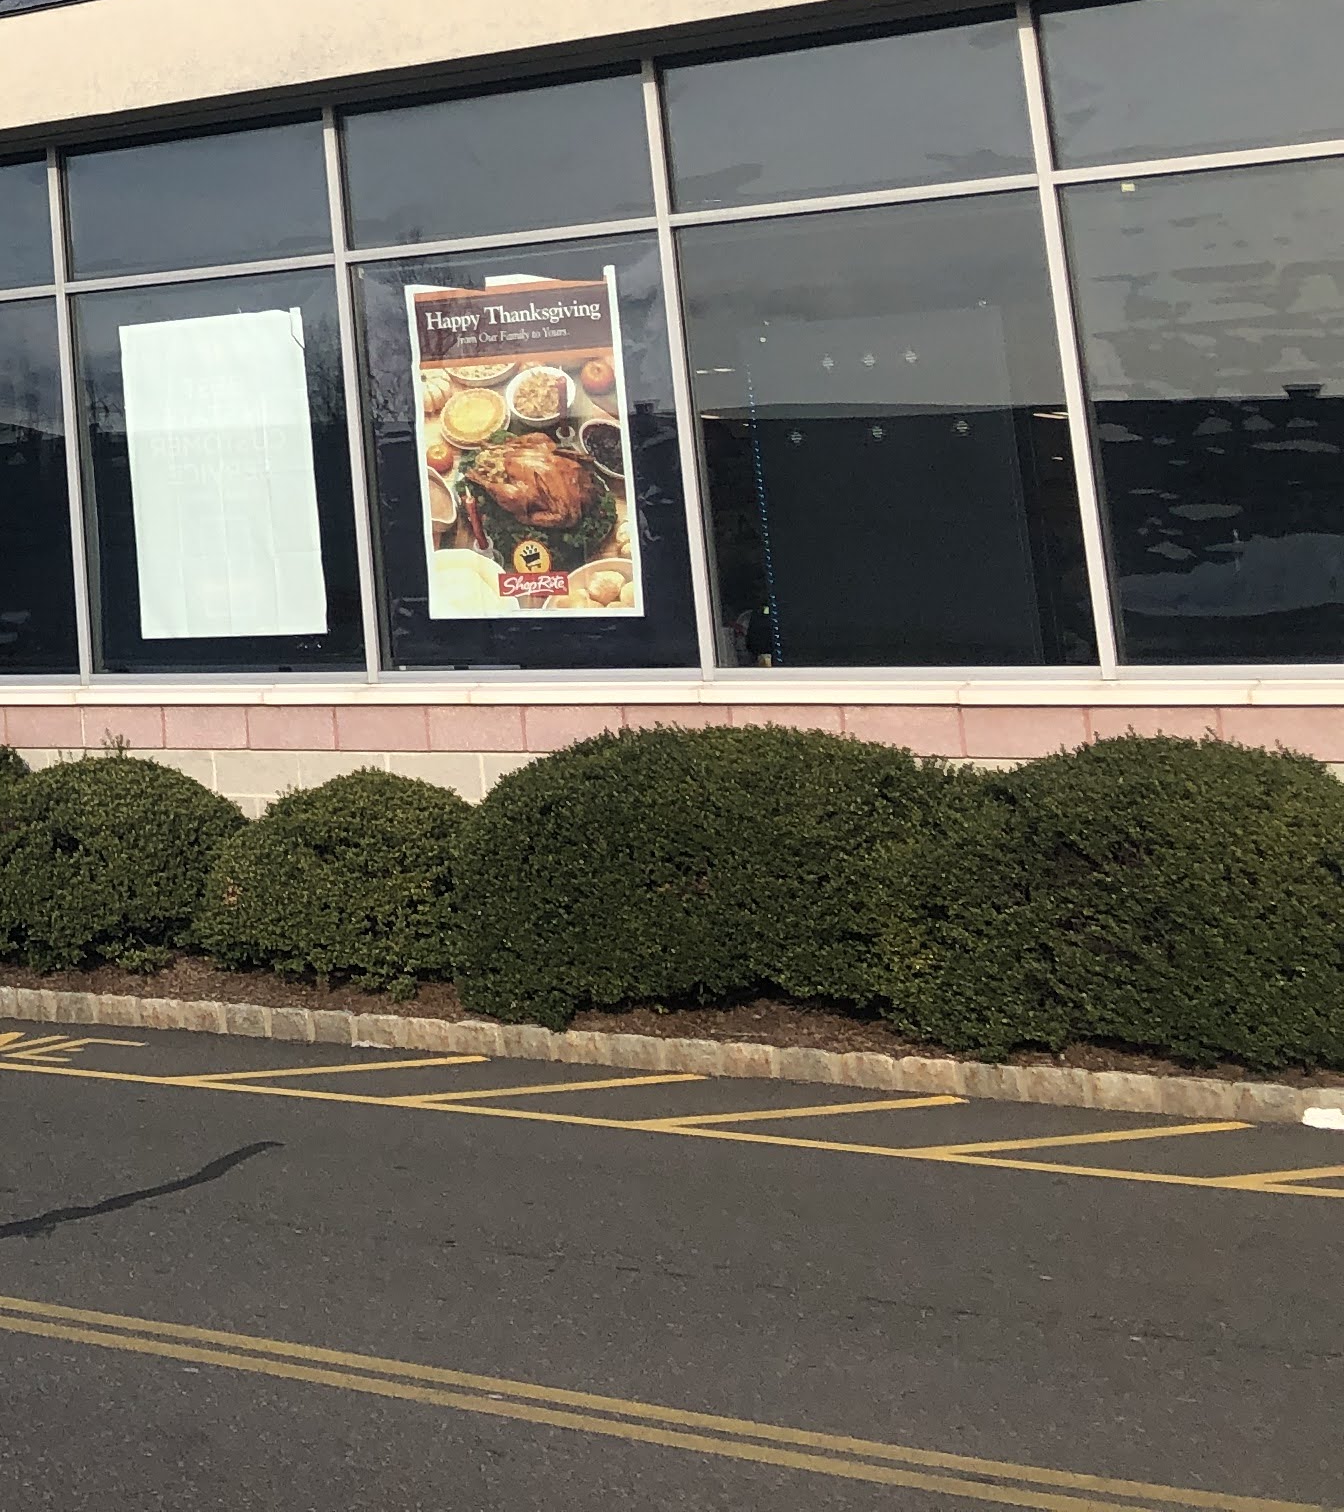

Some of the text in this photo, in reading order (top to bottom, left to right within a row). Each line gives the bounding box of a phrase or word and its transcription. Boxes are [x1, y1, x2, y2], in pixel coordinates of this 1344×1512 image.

[425, 300, 602, 332] Happy Thanksgiving
[457, 333, 477, 347] from
[479, 331, 499, 343] Our
[500, 328, 530, 341] Family
[531, 330, 541, 339] to
[503, 575, 565, 596] ShopRite
